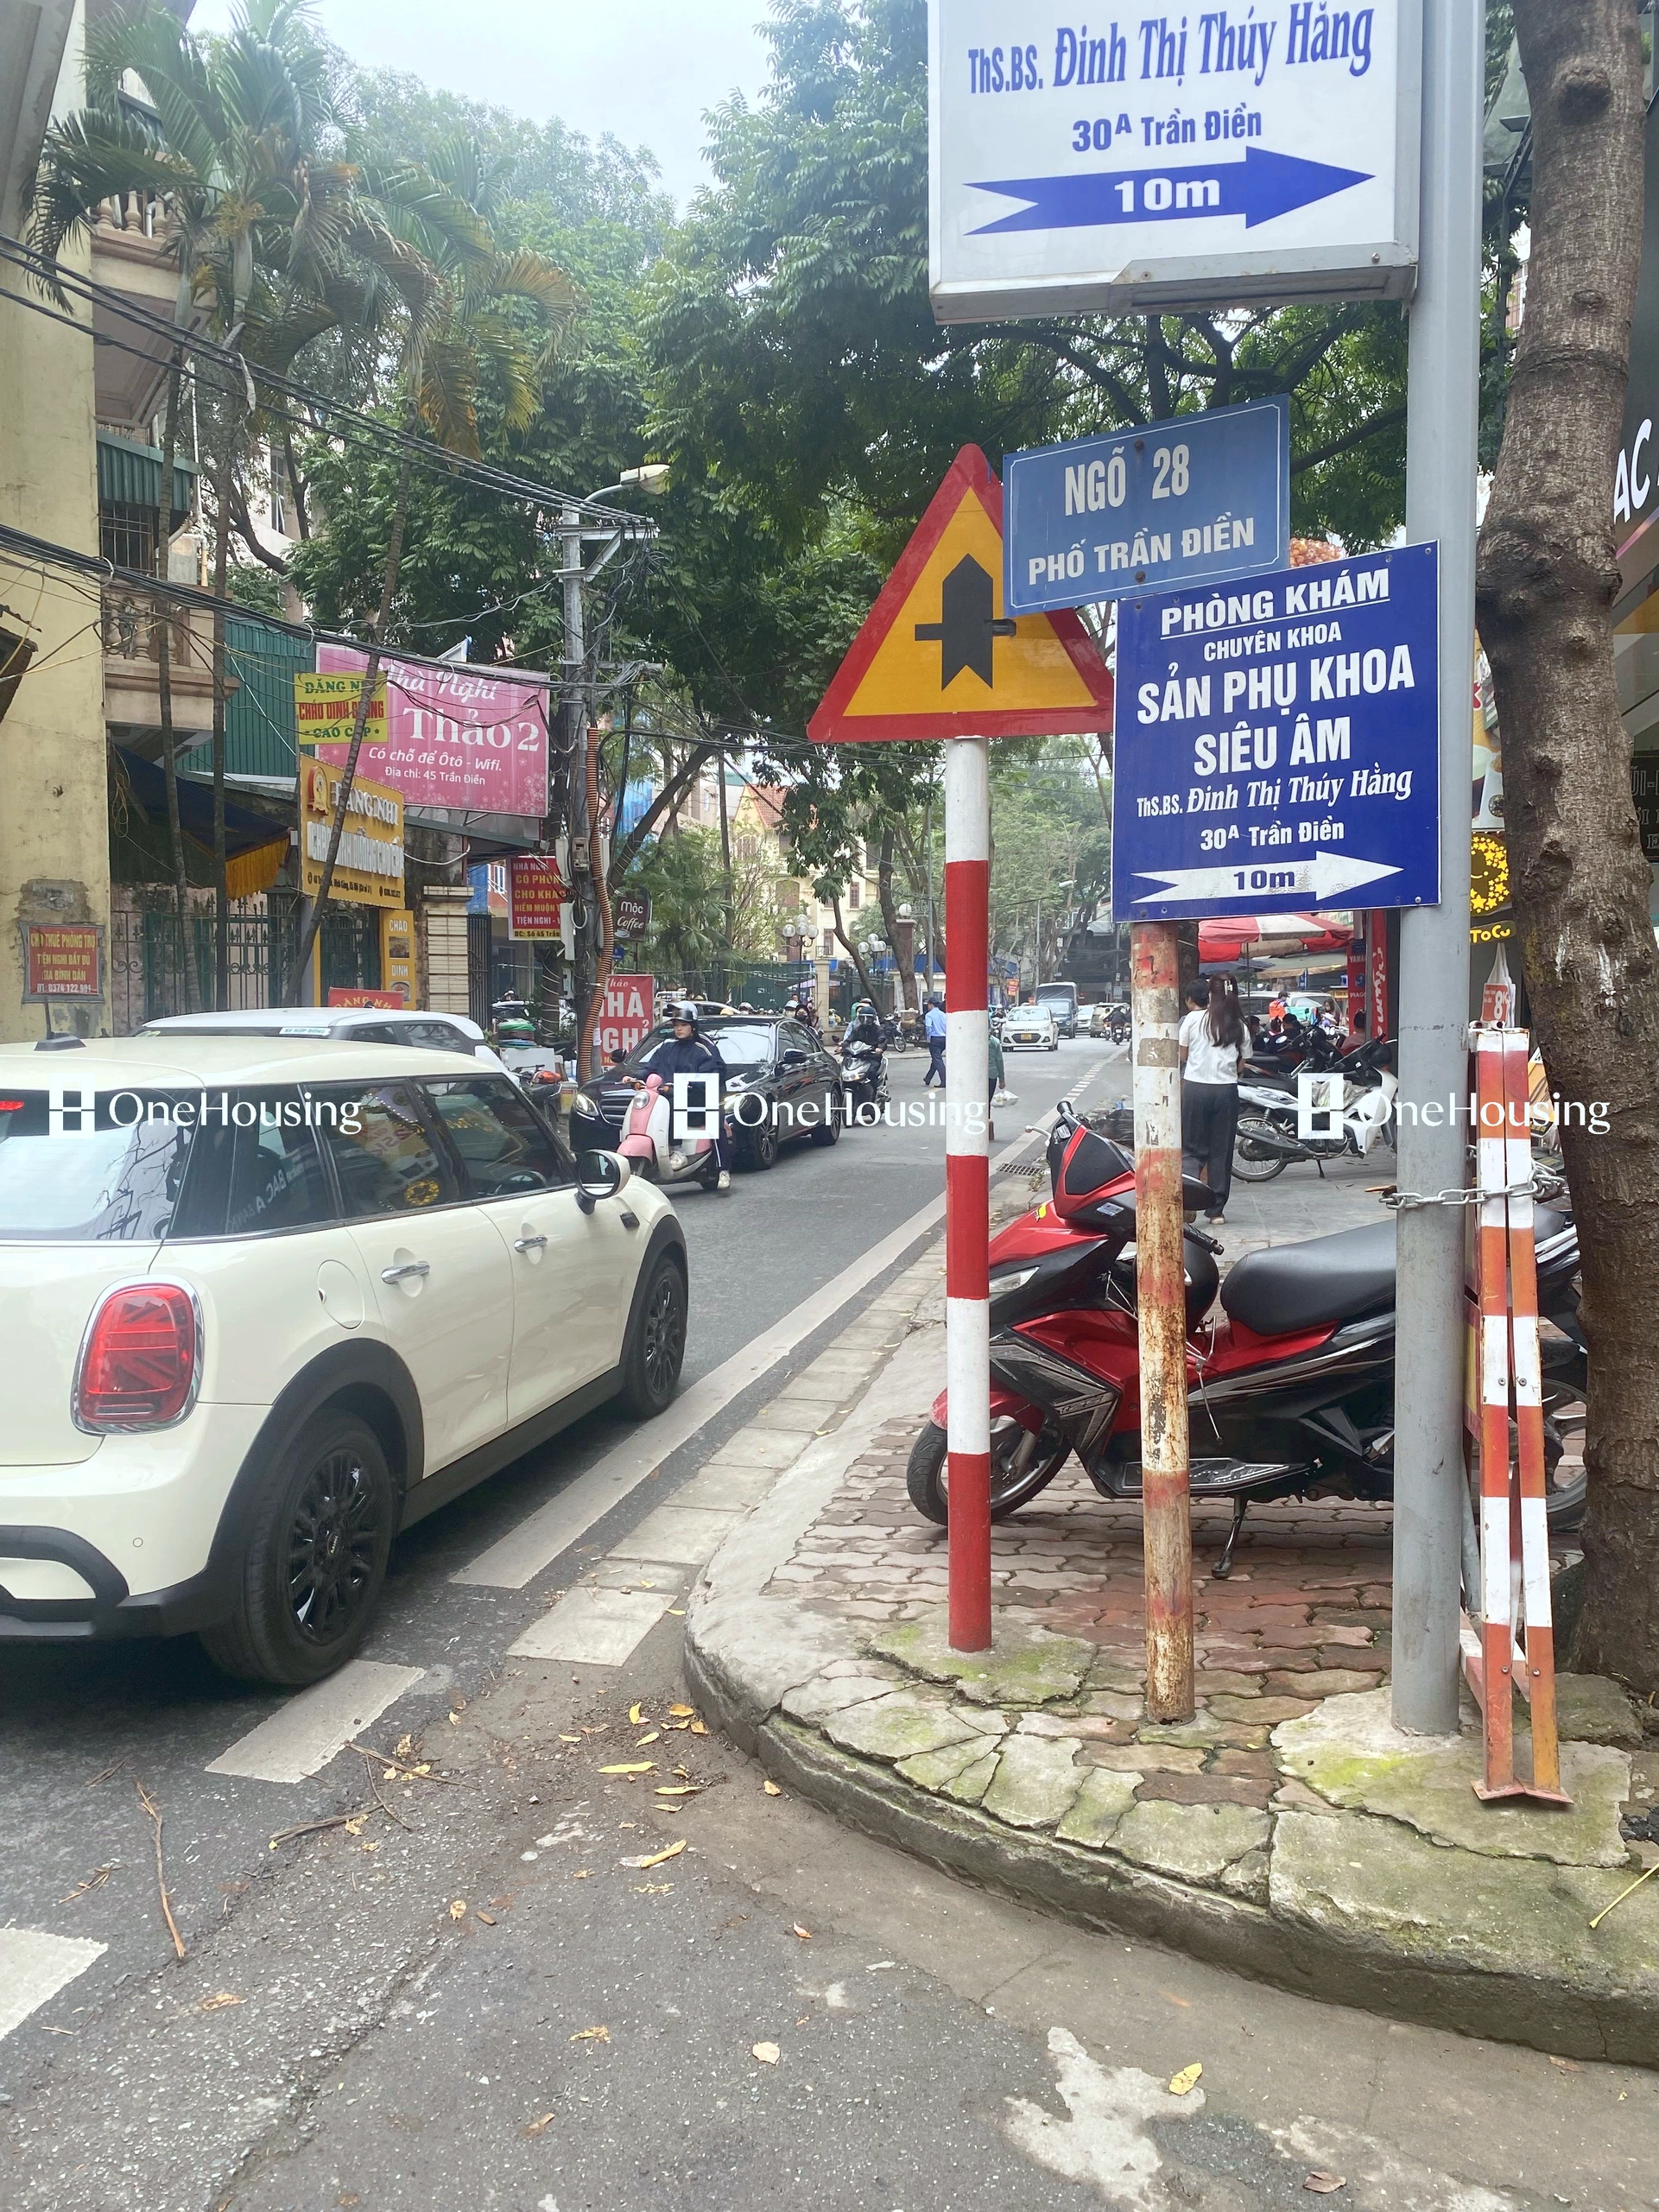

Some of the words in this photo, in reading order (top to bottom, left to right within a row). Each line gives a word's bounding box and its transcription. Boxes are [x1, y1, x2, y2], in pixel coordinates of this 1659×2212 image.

[968, 44, 1043, 94] ThS.BS.
[1052, 23, 1125, 86] Đinh
[1139, 16, 1187, 86] Thị
[1200, 4, 1277, 86] Thúy
[1141, 108, 1195, 147] Trần
[1204, 102, 1262, 142] Điền
[1114, 177, 1220, 213] 10m
[1064, 446, 1127, 517] NGÕ
[1151, 443, 1190, 500] 28
[1029, 538, 1087, 586] PHỐ
[1093, 527, 1172, 574] TRẦN
[1181, 511, 1254, 558] ĐIỀN
[1162, 590, 1274, 636] PHÒNG
[1285, 567, 1390, 615] KHÁM
[1203, 630, 1282, 662] CHUYÊN
[1287, 621, 1342, 649] KHOA
[1137, 662, 1211, 726] SẢN
[1223, 662, 1297, 716] PHỤ
[1310, 644, 1415, 702] KHOA
[517, 722, 541, 752] 2
[1194, 720, 1277, 776] SIÊU
[1289, 713, 1351, 766] ÂM
[368, 746, 387, 760] Có
[389, 747, 416, 763] chỗ
[417, 750, 439, 765] để
[423, 770, 437, 781] 45
[1186, 782, 1238, 813] Đinh
[1246, 778, 1282, 811] Thị
[1288, 773, 1346, 807] Thúy
[1249, 821, 1292, 846] Trần
[1298, 815, 1346, 843] Điền
[515, 890, 535, 899] CHO
[1233, 871, 1295, 891] 10m
[534, 916, 551, 925] NGHI
[617, 916, 644, 930] Coffee
[1349, 954, 1365, 963] YAMA
